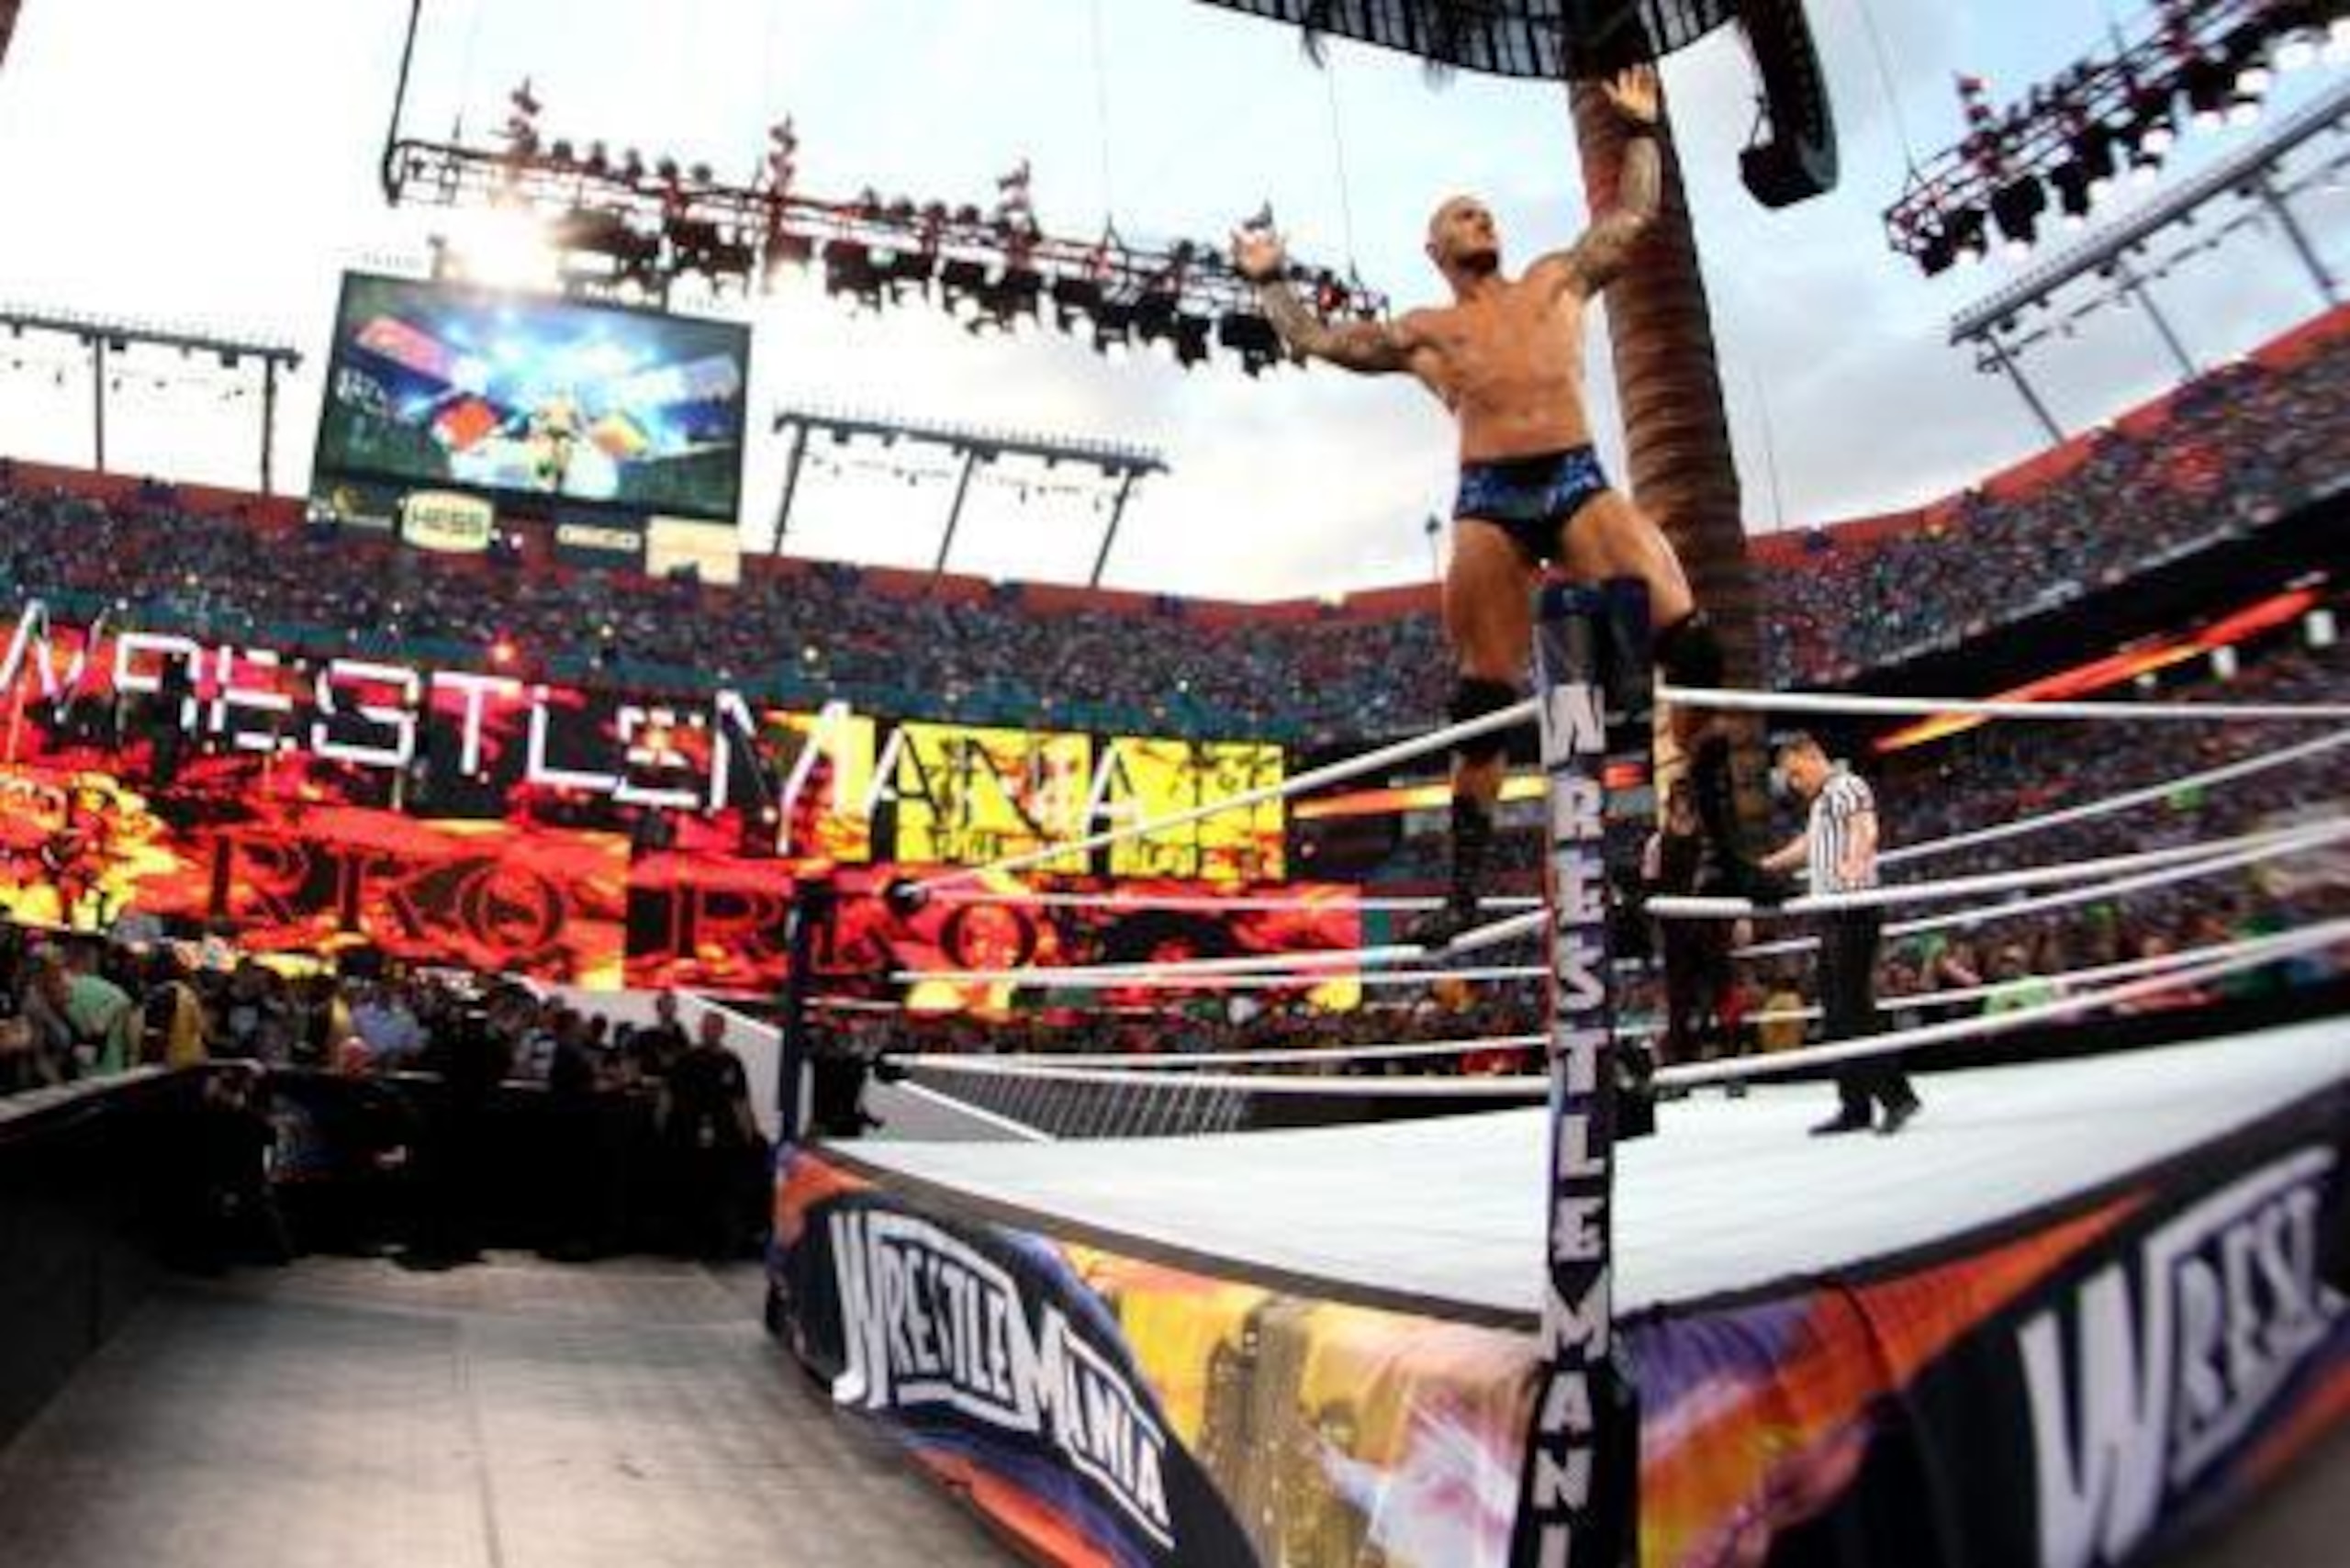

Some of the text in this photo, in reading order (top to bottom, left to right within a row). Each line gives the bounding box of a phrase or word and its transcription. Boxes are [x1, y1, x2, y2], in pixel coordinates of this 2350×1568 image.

[0, 599, 1160, 854] WRESTLEMANA
[207, 832, 565, 953] RKO
[831, 1209, 1175, 1550] WRESTLEMANIA
